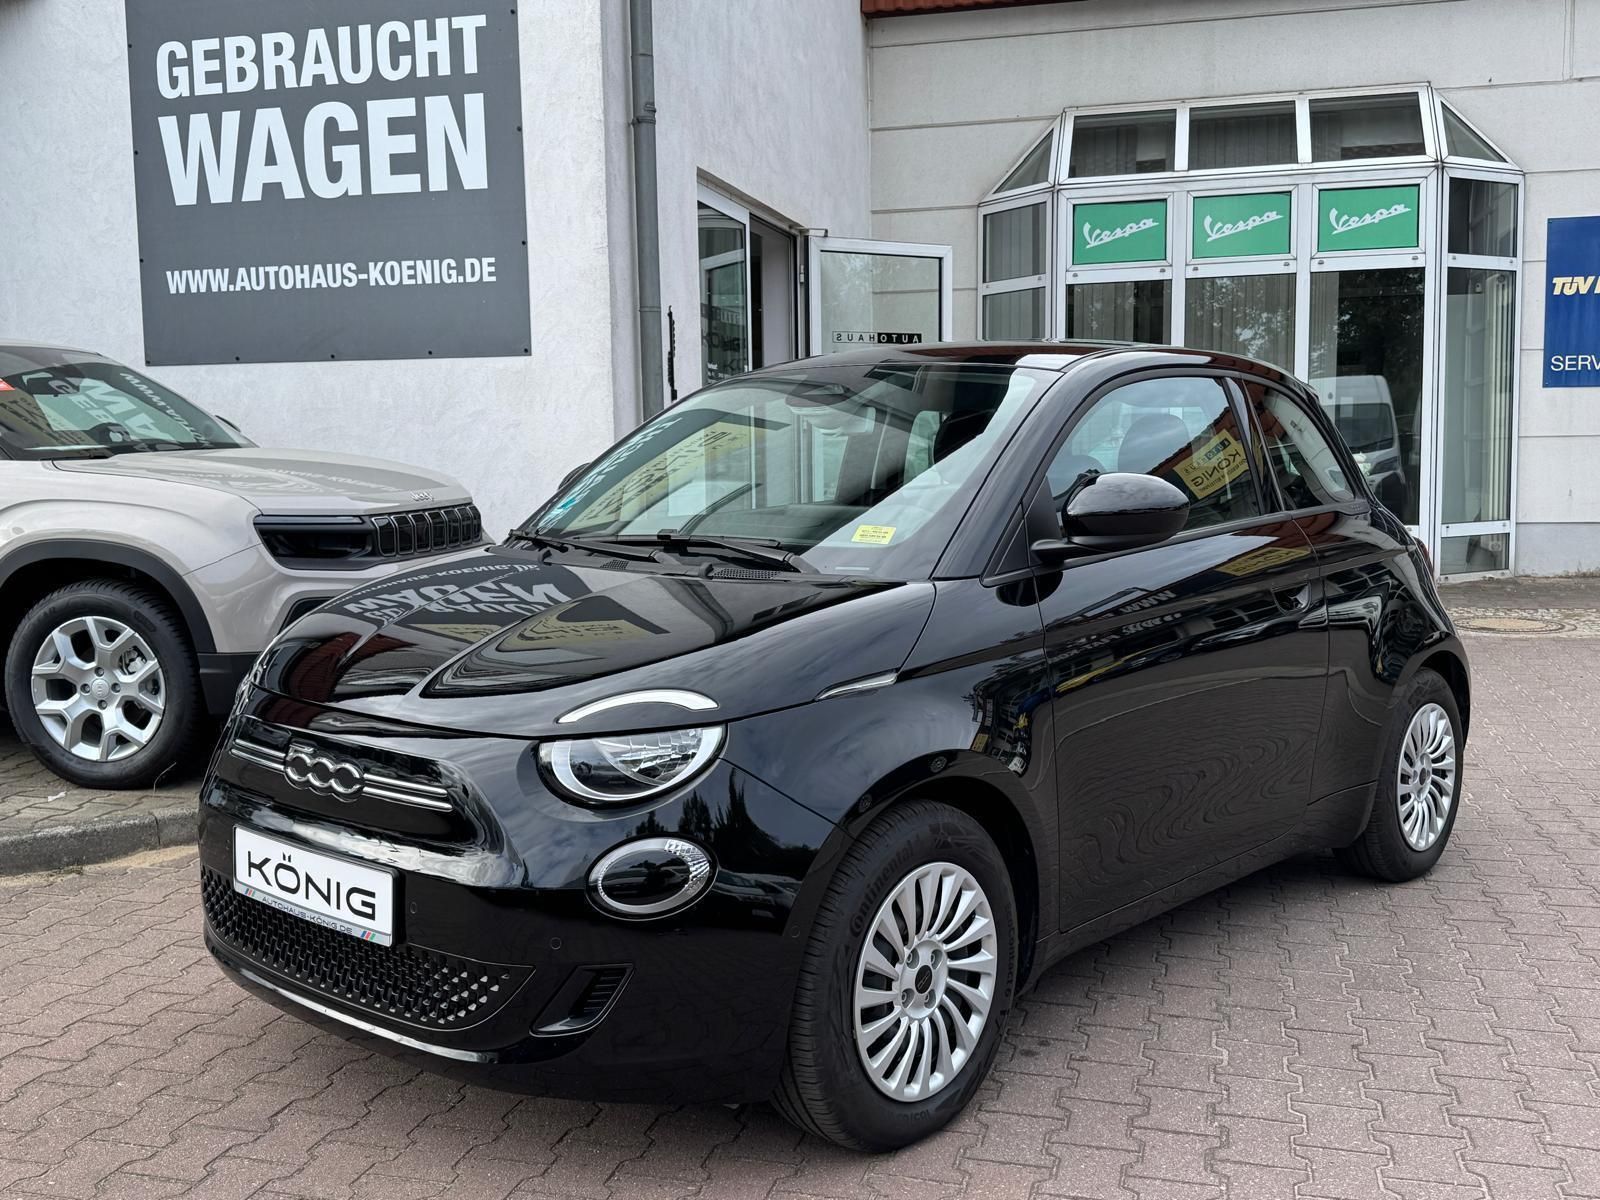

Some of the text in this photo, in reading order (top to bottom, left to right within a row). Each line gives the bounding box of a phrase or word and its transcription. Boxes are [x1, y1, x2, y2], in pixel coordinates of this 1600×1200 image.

[156, 14, 487, 99] GEBRAUCHT
[158, 92, 489, 206] WAGEN
[1083, 218, 1160, 249] Vespa
[1204, 211, 1284, 242] Vespa
[1329, 203, 1412, 235] Vespa
[166, 257, 497, 294] WWW.AUTOHAUS-KOENIG.DE
[286, 743, 362, 795] 500
[247, 850, 376, 921] KÖNIG
